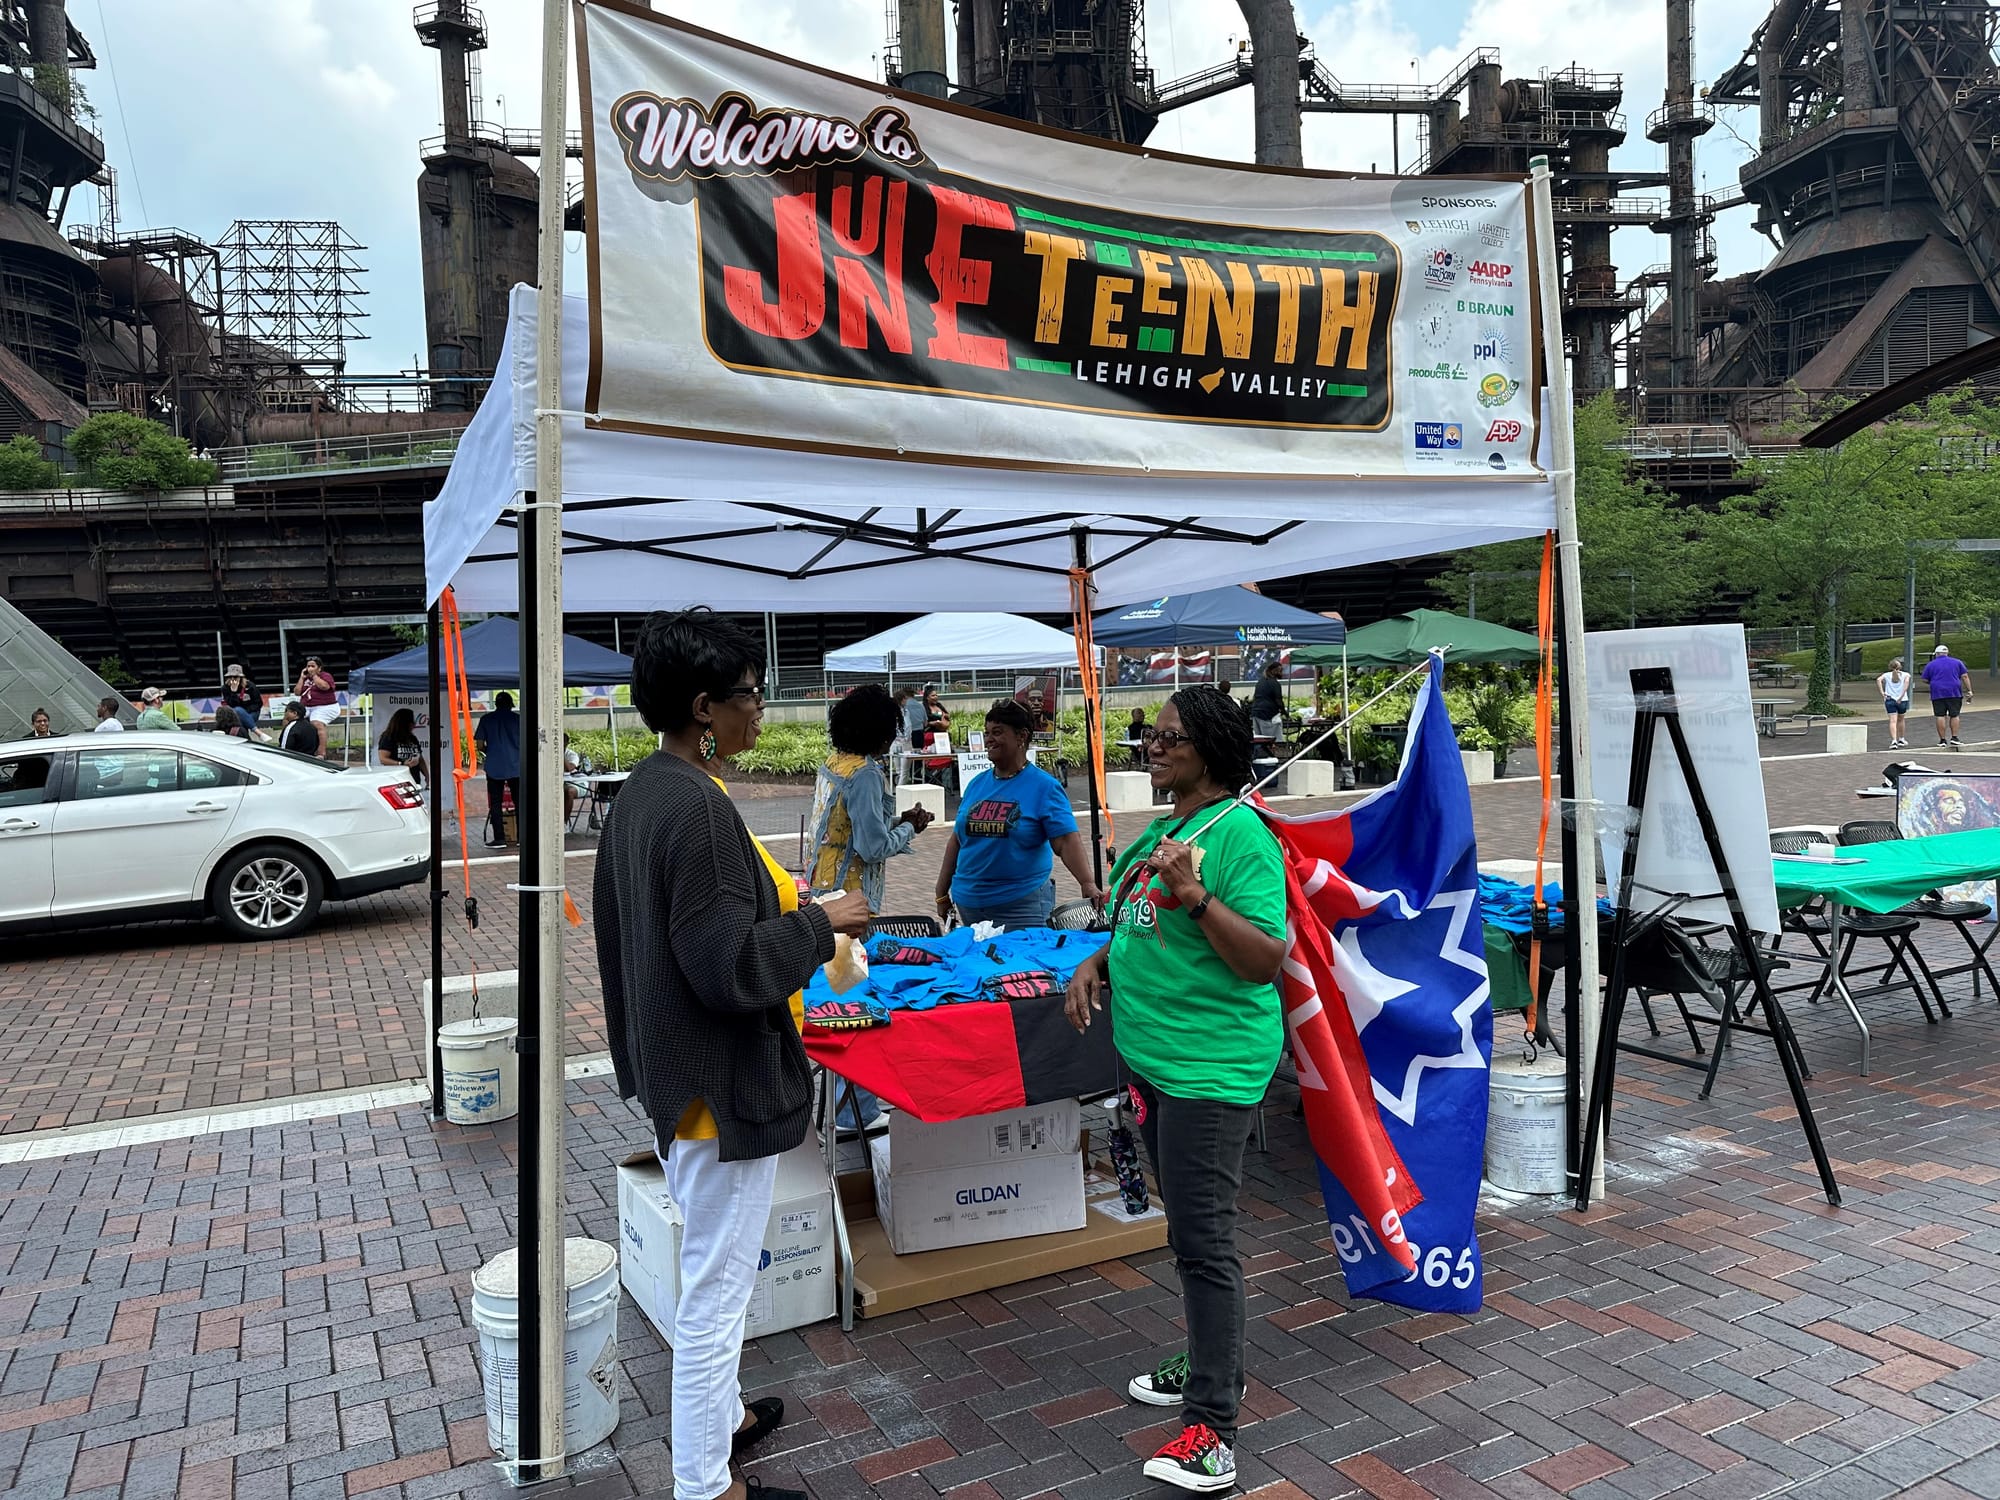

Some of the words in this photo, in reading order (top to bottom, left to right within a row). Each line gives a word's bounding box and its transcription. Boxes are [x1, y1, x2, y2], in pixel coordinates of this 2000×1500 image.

[624, 101, 859, 170] Welcome
[872, 113, 916, 160] to
[1421, 197, 1497, 209] SPONSORS:
[1421, 219, 1470, 231] LEHIGH
[1477, 222, 1510, 239] LAFAYETTE
[1480, 235, 1504, 249] COLLEGE
[1467, 260, 1512, 279] AARP
[1469, 275, 1513, 288] Pennsylvania
[1468, 301, 1514, 316] BRAUN
[1473, 340, 1496, 360] ppl
[1436, 362, 1450, 371] AIR
[1077, 359, 1191, 389] LEHIGH
[1231, 371, 1327, 399] VALLEY
[1408, 368, 1450, 380] PRODUCTS
[1416, 424, 1442, 435] United
[1485, 419, 1521, 442] ADP
[1426, 435, 1443, 447] Way
[1246, 626, 1267, 635] Lehigh
[1267, 626, 1285, 635] Valley
[389, 696, 423, 705] Changing
[971, 801, 1013, 821] JUNE
[969, 822, 1005, 833] TEENTH
[1132, 898, 1157, 928] 19
[453, 1084, 486, 1092] Driveway
[956, 1183, 1021, 1205] GILDAN
[623, 1218, 643, 1252] GILDAN
[773, 1244, 800, 1256] GENUINE
[774, 1246, 821, 1262] RESPONSIBILITY
